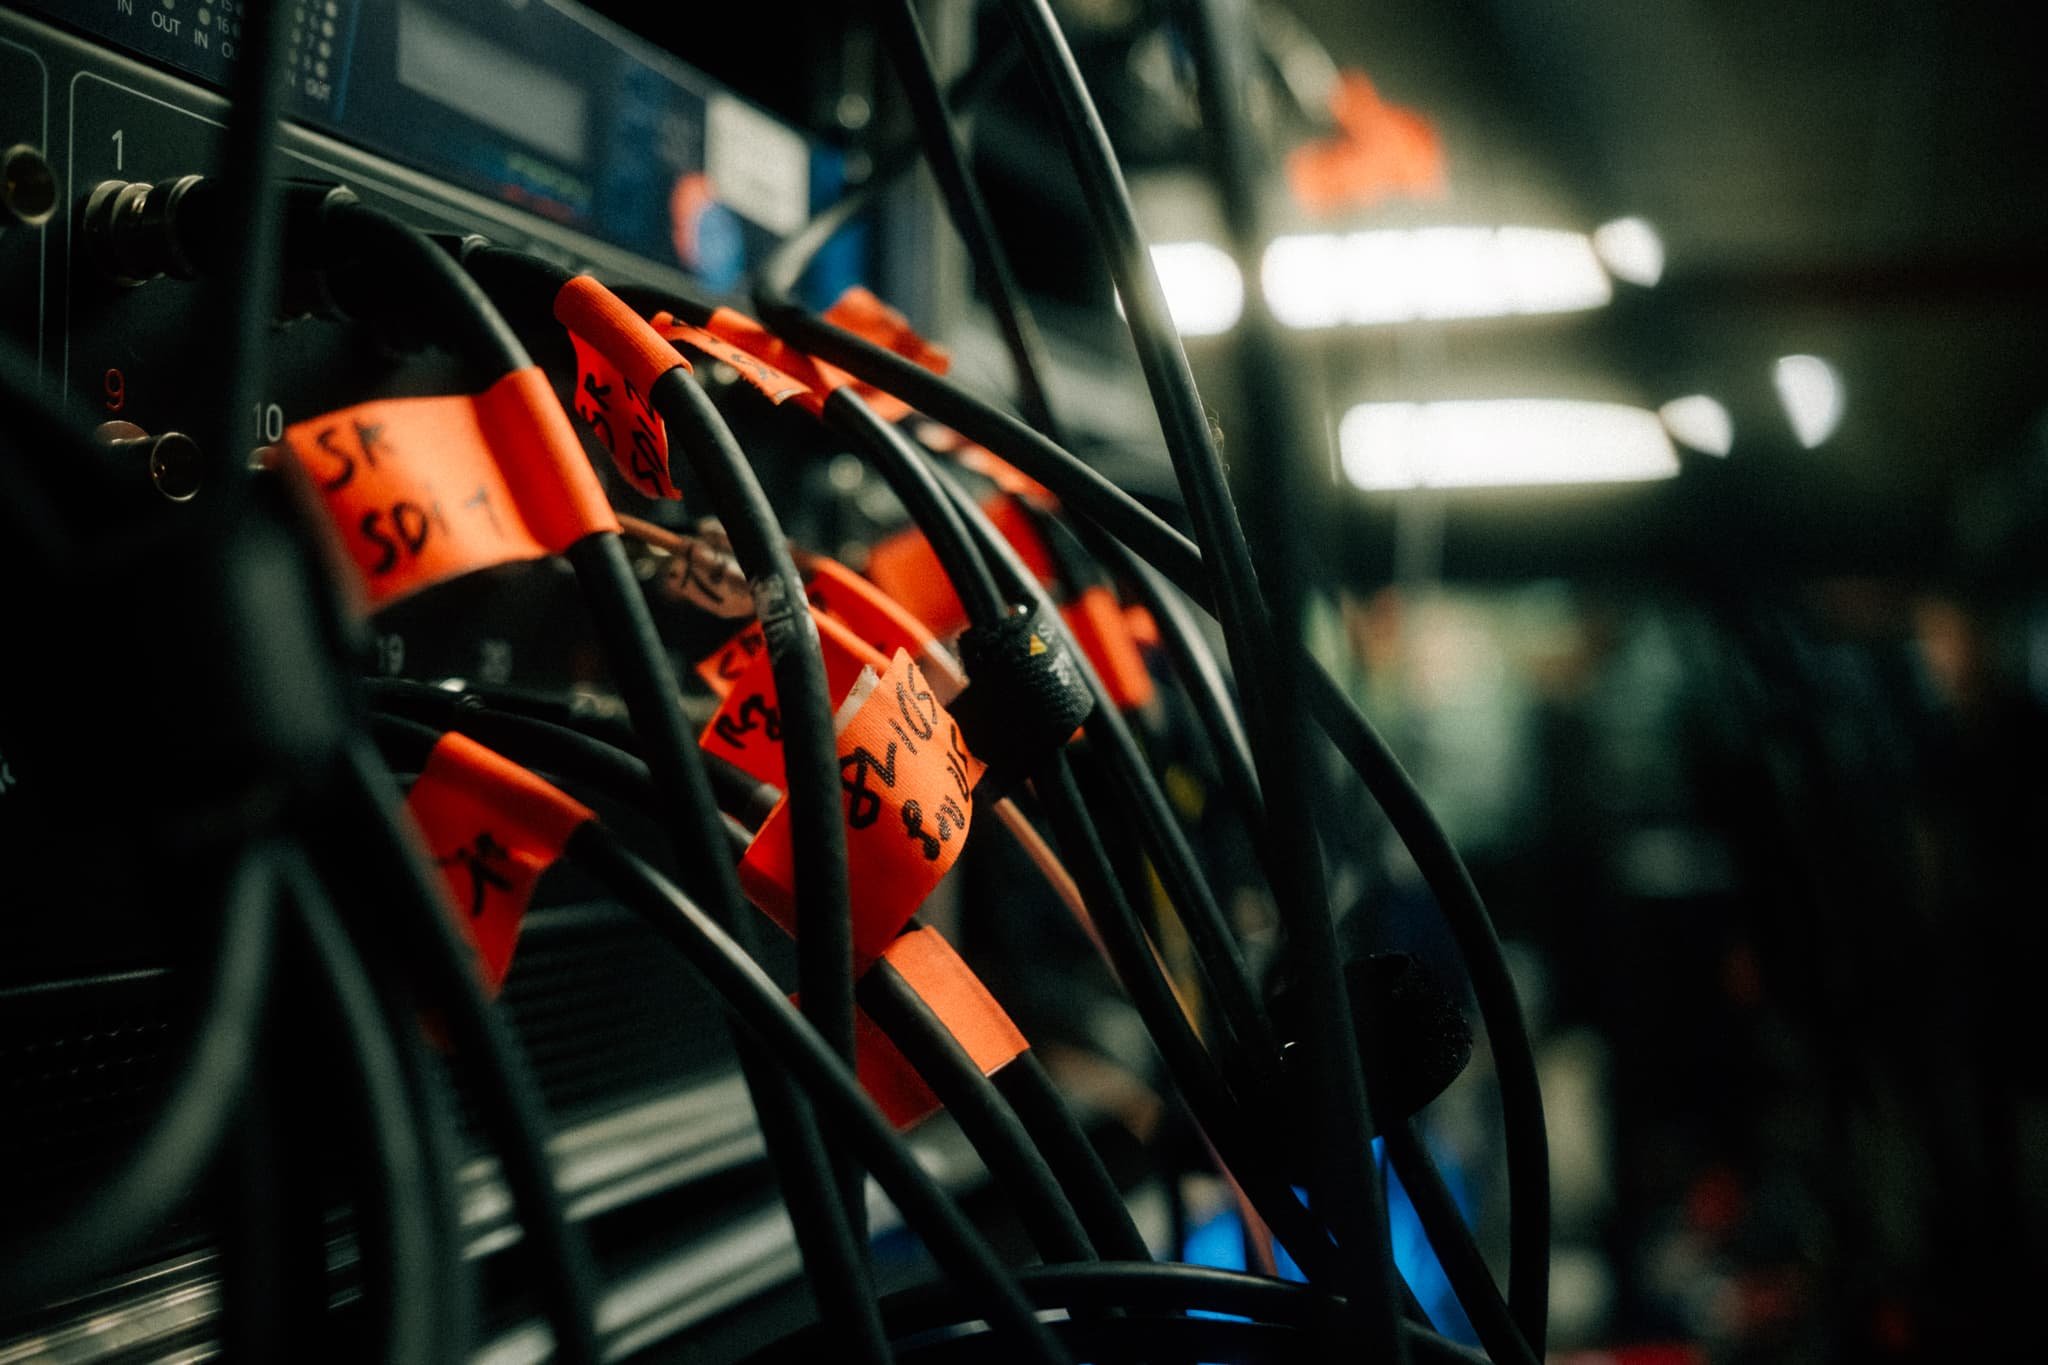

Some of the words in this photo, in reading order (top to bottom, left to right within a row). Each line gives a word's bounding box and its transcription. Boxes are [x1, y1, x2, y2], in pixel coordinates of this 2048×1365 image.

[151, 11, 182, 36] OUT
[193, 28, 209, 50] IN
[216, 15, 230, 34] 16
[111, 128, 124, 172] 1
[103, 367, 126, 413] 9
[254, 399, 284, 443] 10
